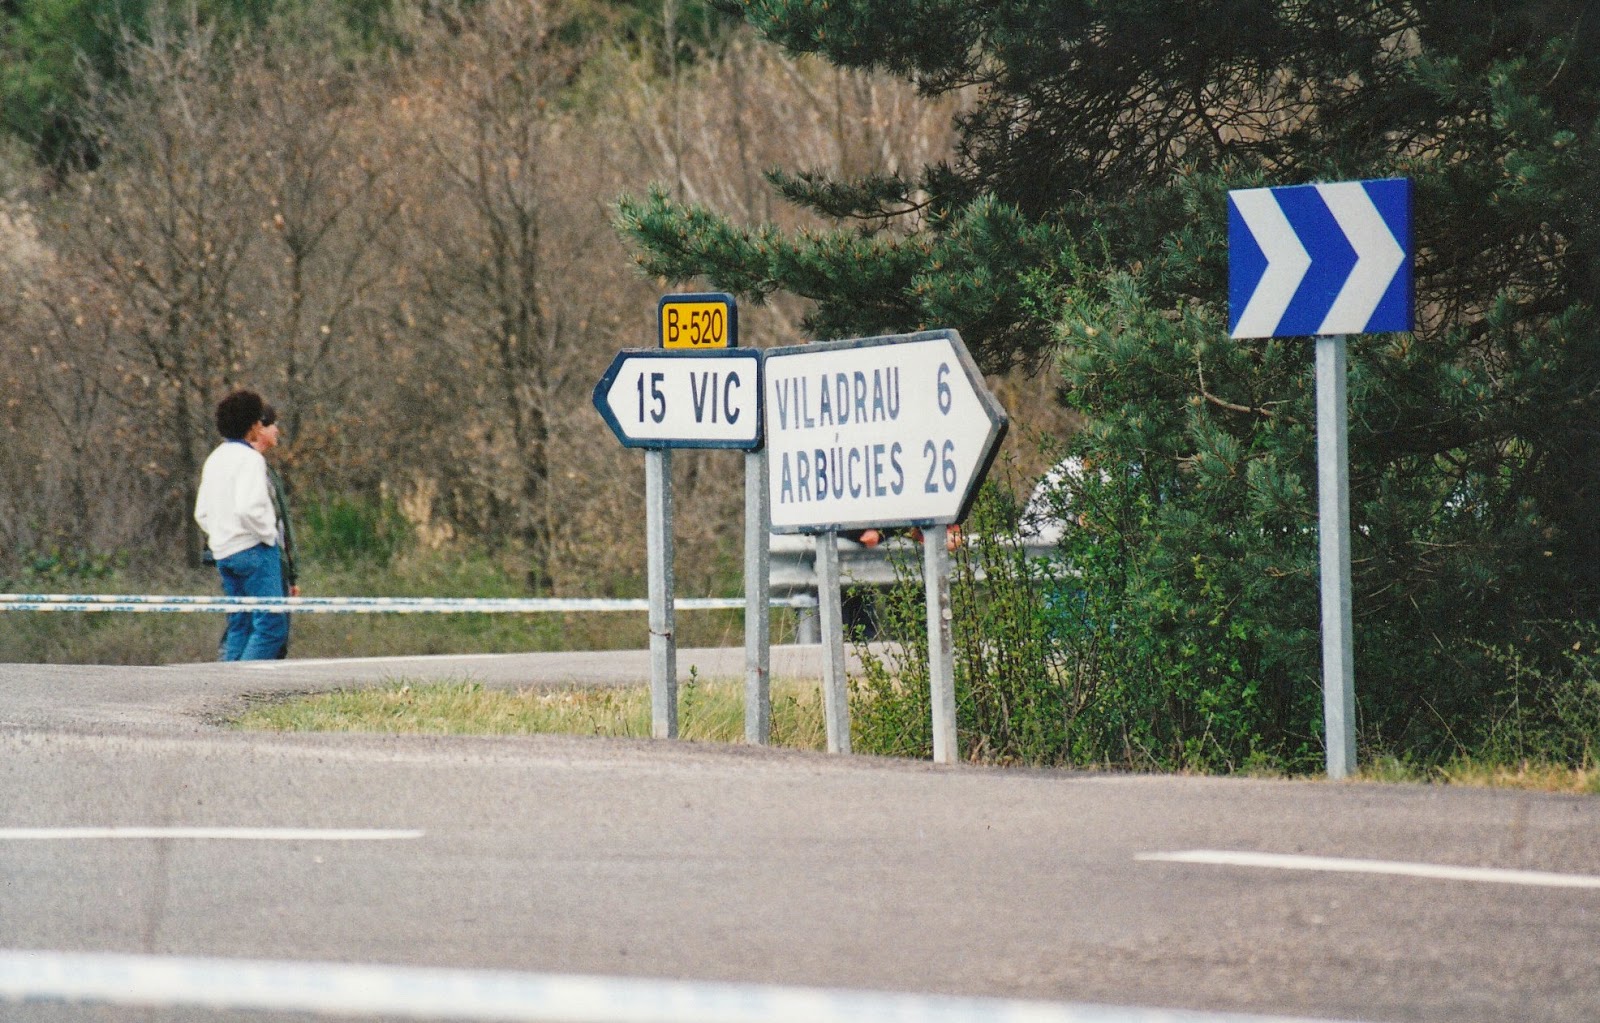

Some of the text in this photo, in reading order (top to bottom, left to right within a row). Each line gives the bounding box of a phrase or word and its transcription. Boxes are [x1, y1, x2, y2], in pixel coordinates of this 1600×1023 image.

[668, 307, 723, 345] B-520
[637, 371, 741, 425] 15 VIC
[775, 362, 952, 430] VILADRAU 6
[780, 433, 956, 504] ARBÚCIES 26
